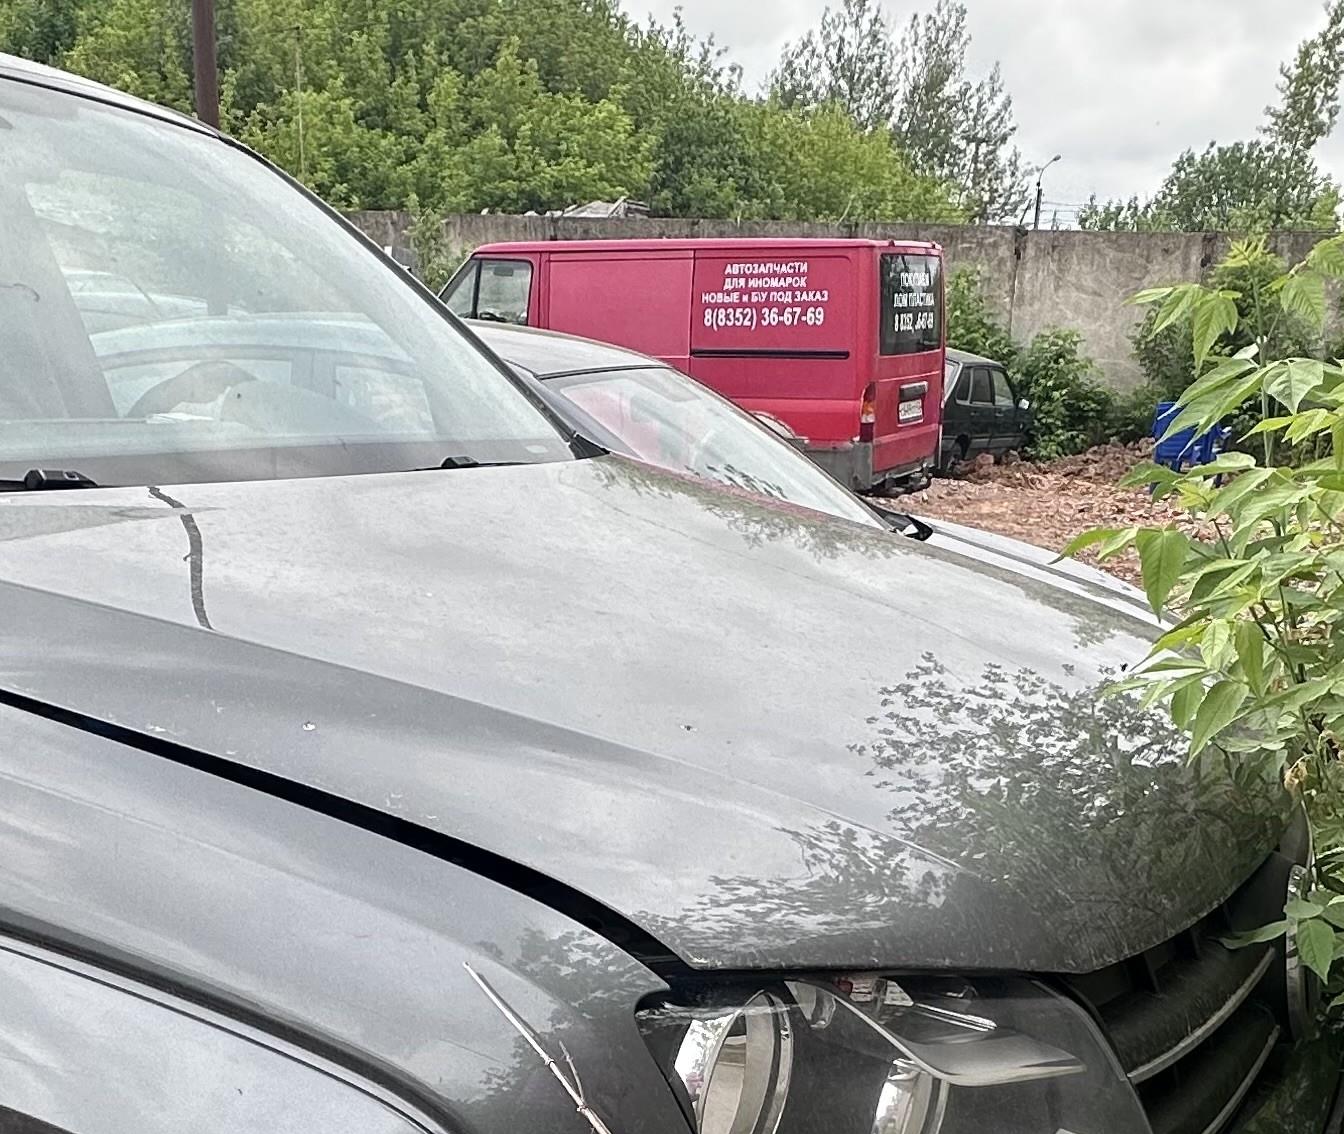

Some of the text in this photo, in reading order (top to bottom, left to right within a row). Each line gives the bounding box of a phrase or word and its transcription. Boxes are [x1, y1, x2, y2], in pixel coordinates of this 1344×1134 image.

[724, 261, 808, 275] АВТОЗАПЧАСТИ
[723, 276, 808, 290] ДЛЯ ИНОМАРОК
[701, 291, 740, 303] НОВЫЕ
[769, 290, 792, 303] ПОД
[794, 290, 829, 301] ЗАКАЗ
[703, 306, 825, 331] 8(8352) 36-67-69
